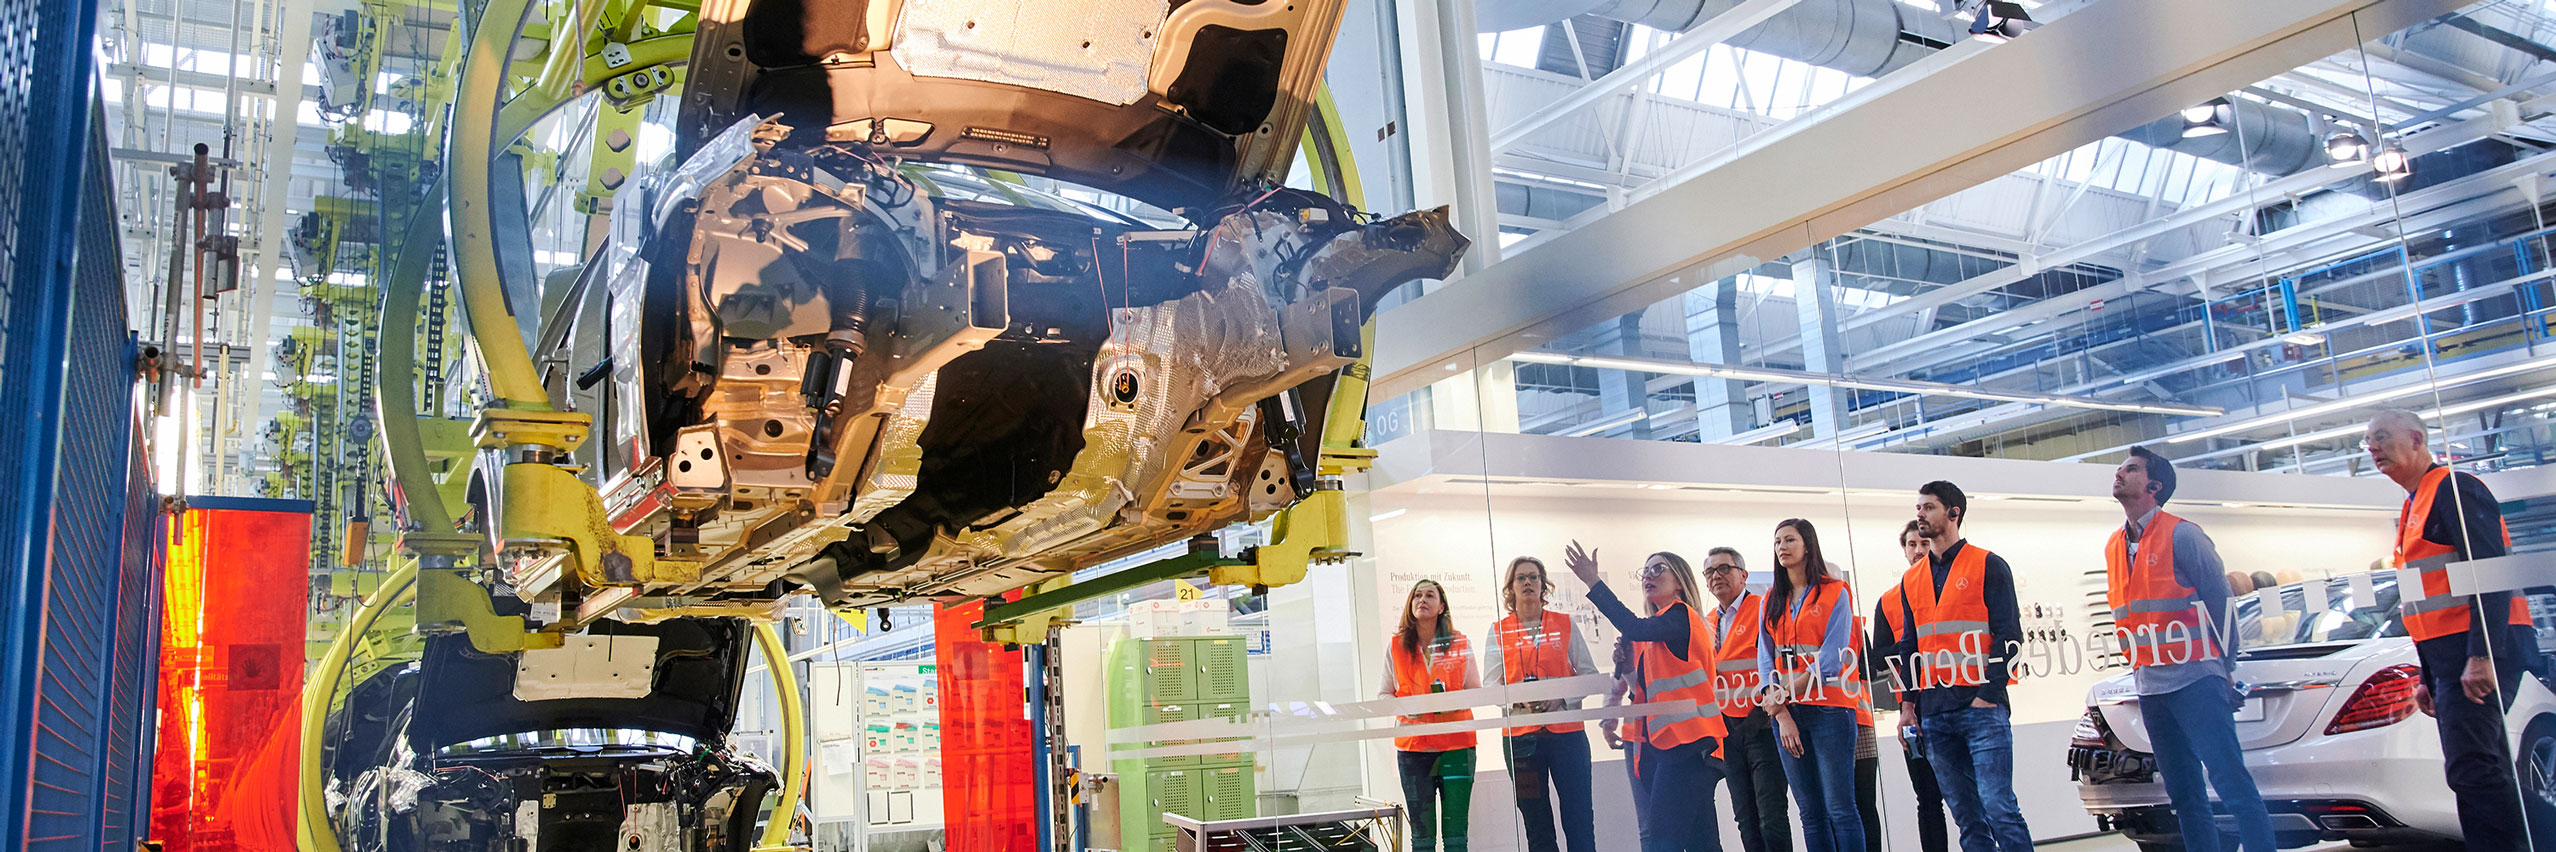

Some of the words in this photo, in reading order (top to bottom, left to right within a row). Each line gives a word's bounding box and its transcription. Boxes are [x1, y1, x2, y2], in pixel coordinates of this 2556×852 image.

[1377, 411, 1398, 436] OG
[1390, 572, 1428, 581] Produktion
[1431, 572, 1442, 581] mit
[1445, 572, 1473, 581] Zukunft.
[1180, 588, 1195, 600] 21
[1445, 584, 1477, 594] roduction.
